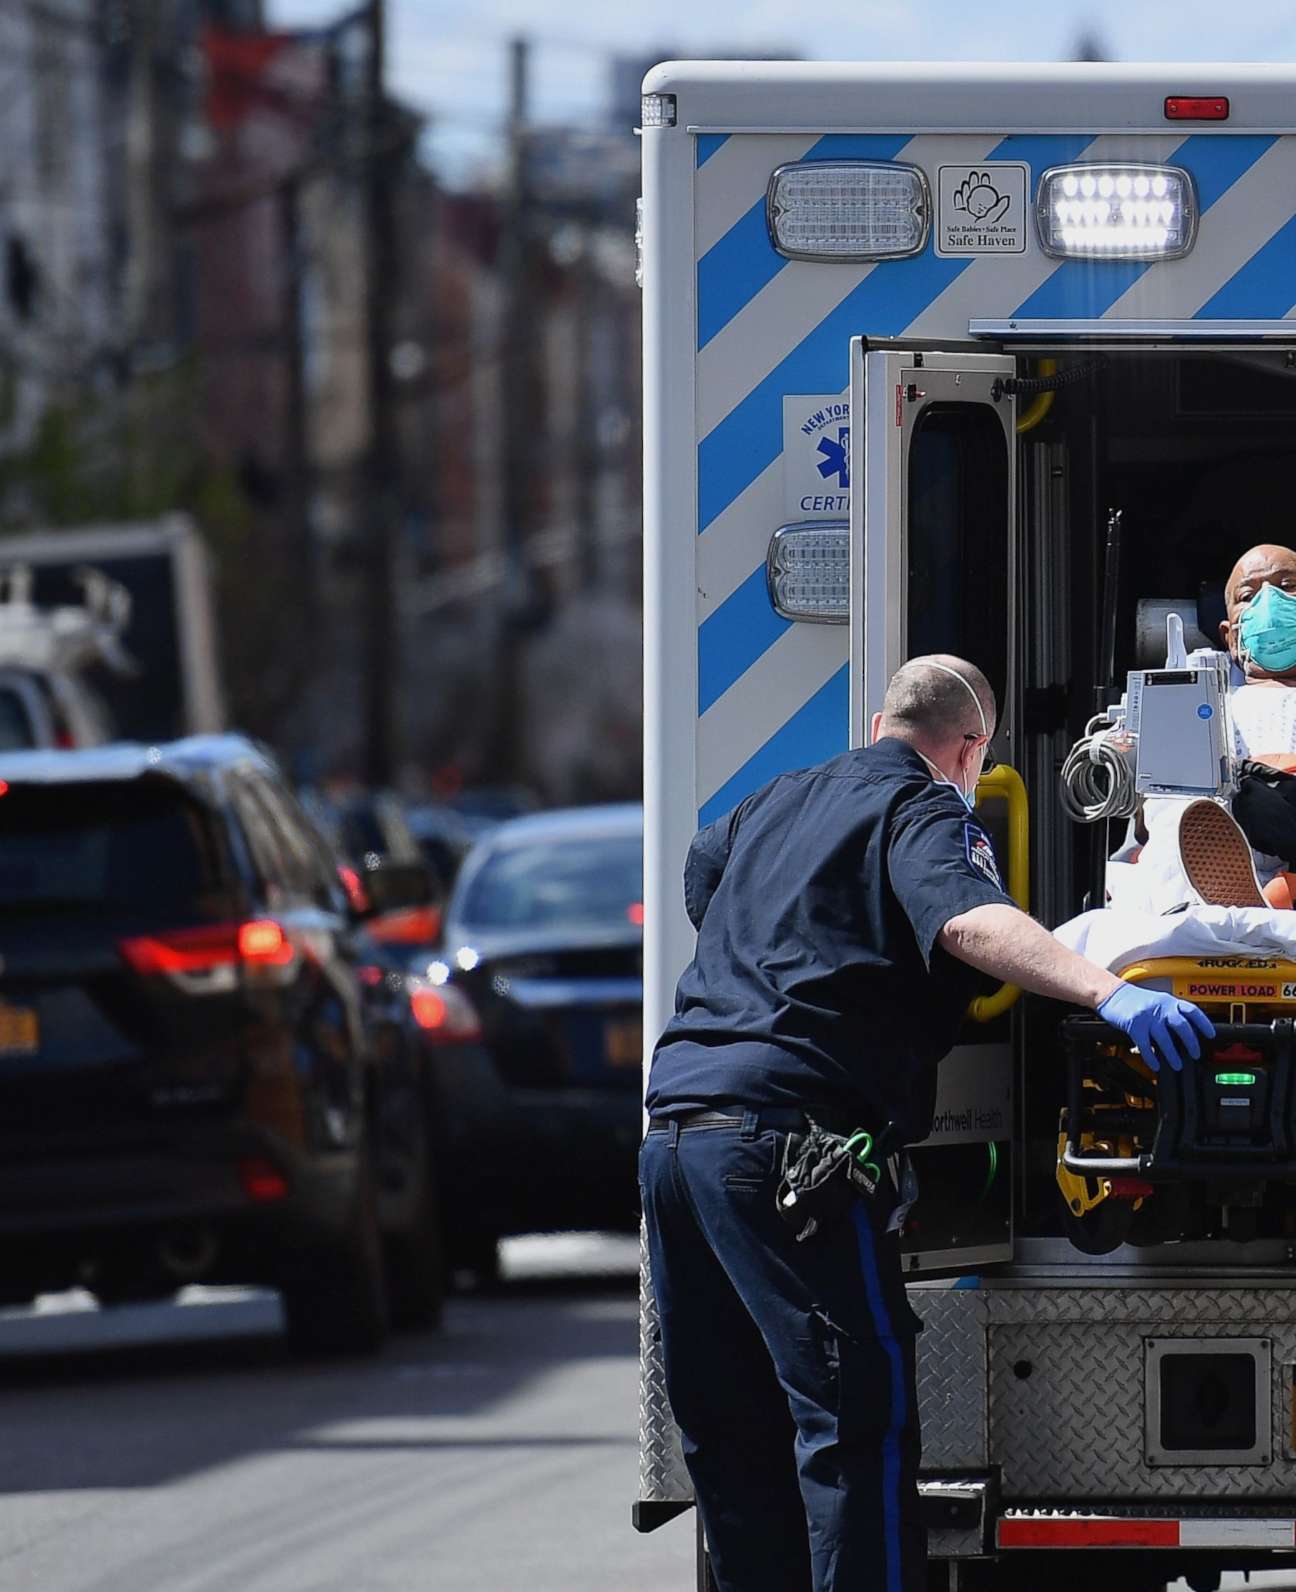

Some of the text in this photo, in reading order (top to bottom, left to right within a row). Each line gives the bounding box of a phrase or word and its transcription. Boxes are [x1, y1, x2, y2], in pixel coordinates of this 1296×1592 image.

[948, 235, 1015, 246] Safe Haven
[801, 411, 825, 435] NEW
[1190, 985, 1236, 996] POWER
[1242, 985, 1275, 996] LOAD
[931, 1107, 973, 1132] orthwell
